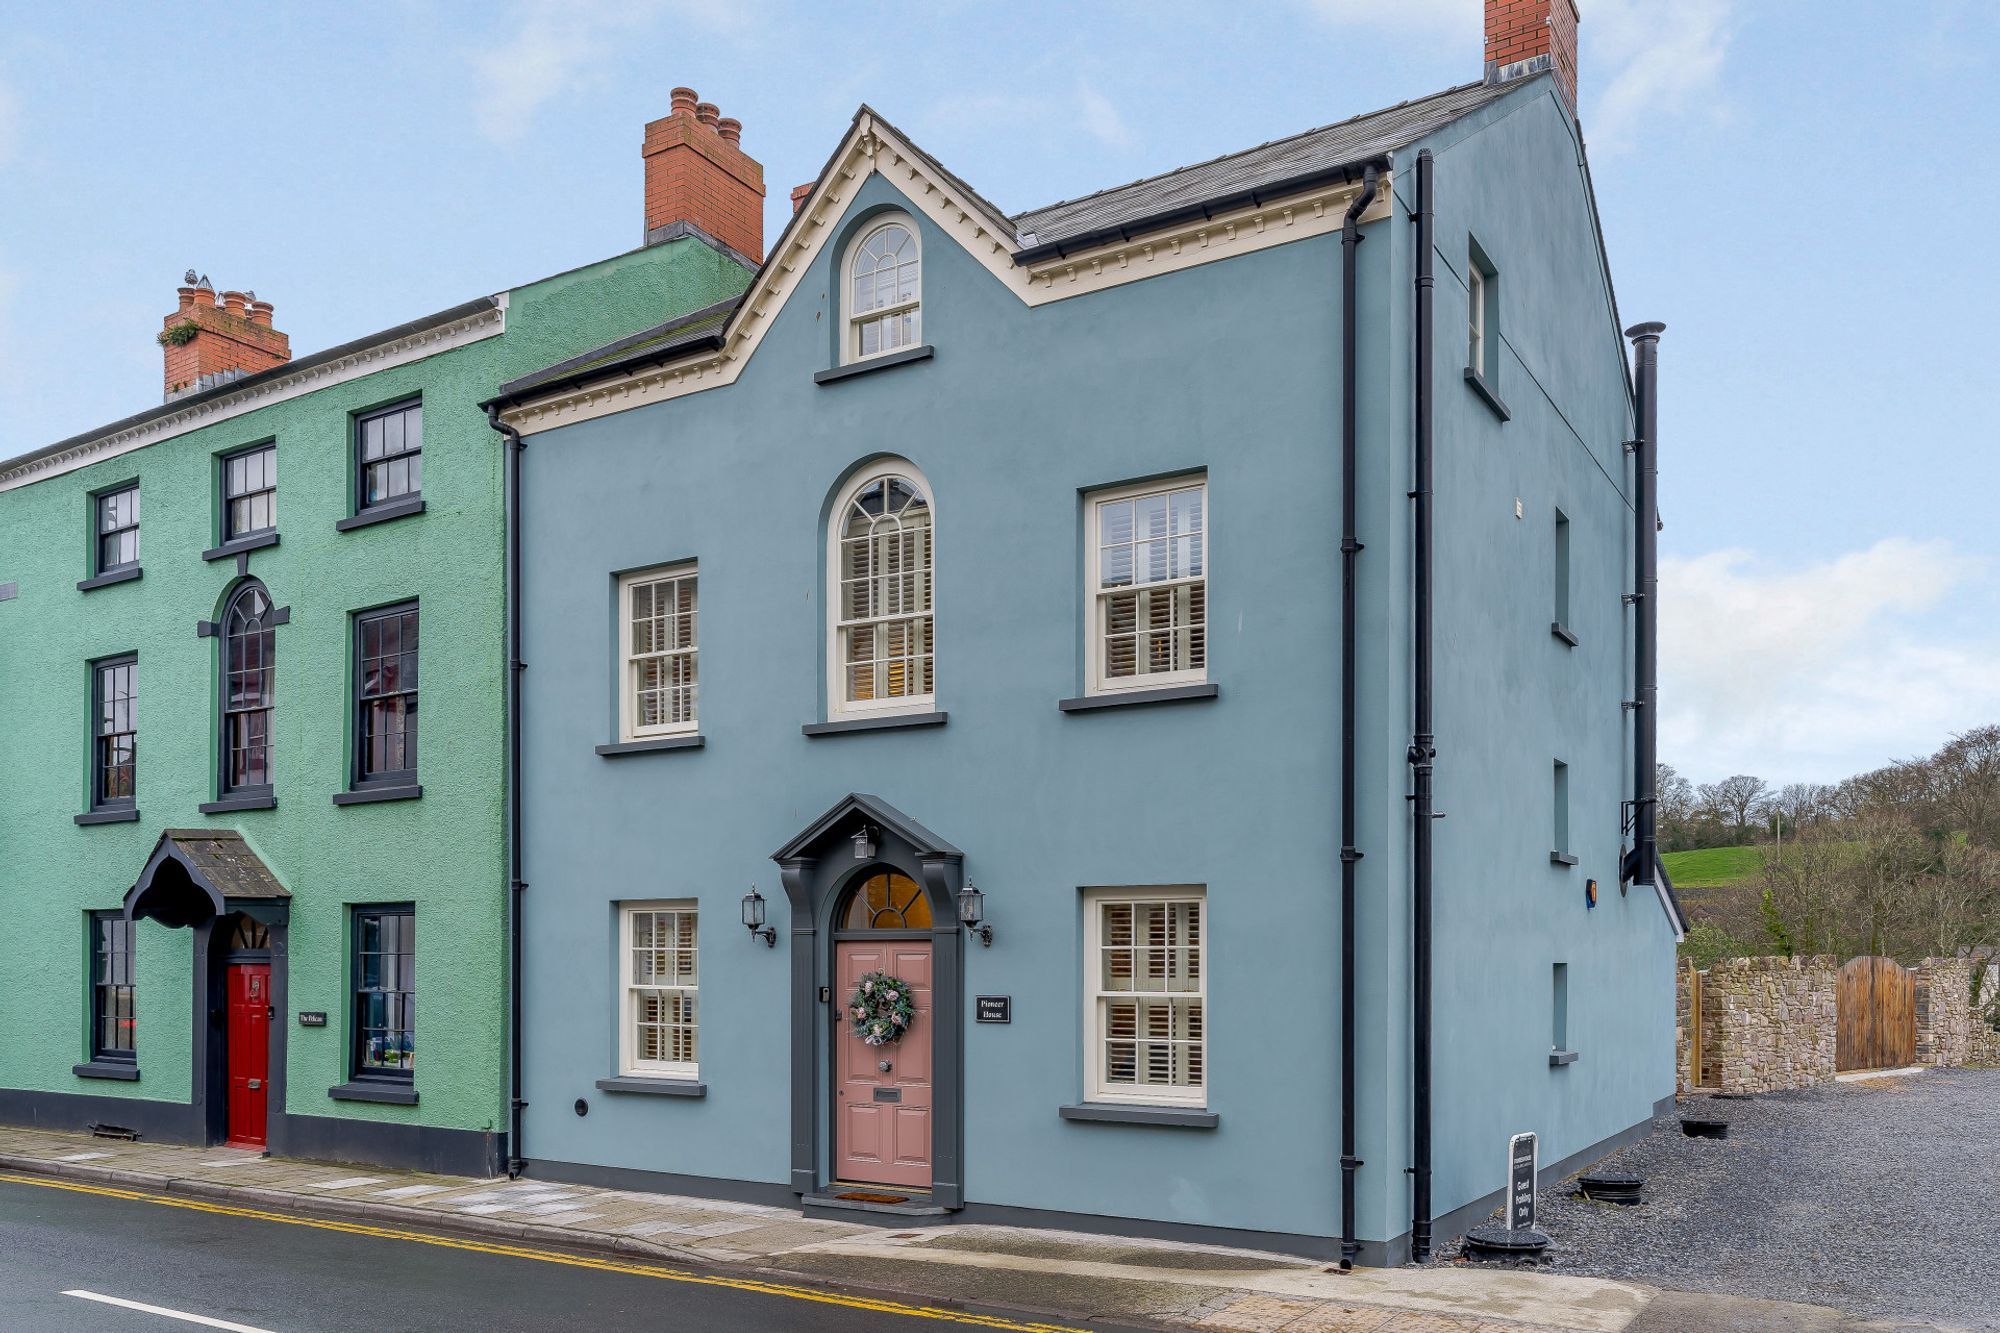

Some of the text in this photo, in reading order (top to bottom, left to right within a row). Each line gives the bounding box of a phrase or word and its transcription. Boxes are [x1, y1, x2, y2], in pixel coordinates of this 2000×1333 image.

[1517, 1179, 1529, 1190] Guest
[1516, 1193, 1531, 1204] Parking
[1519, 1206, 1529, 1216] Only
